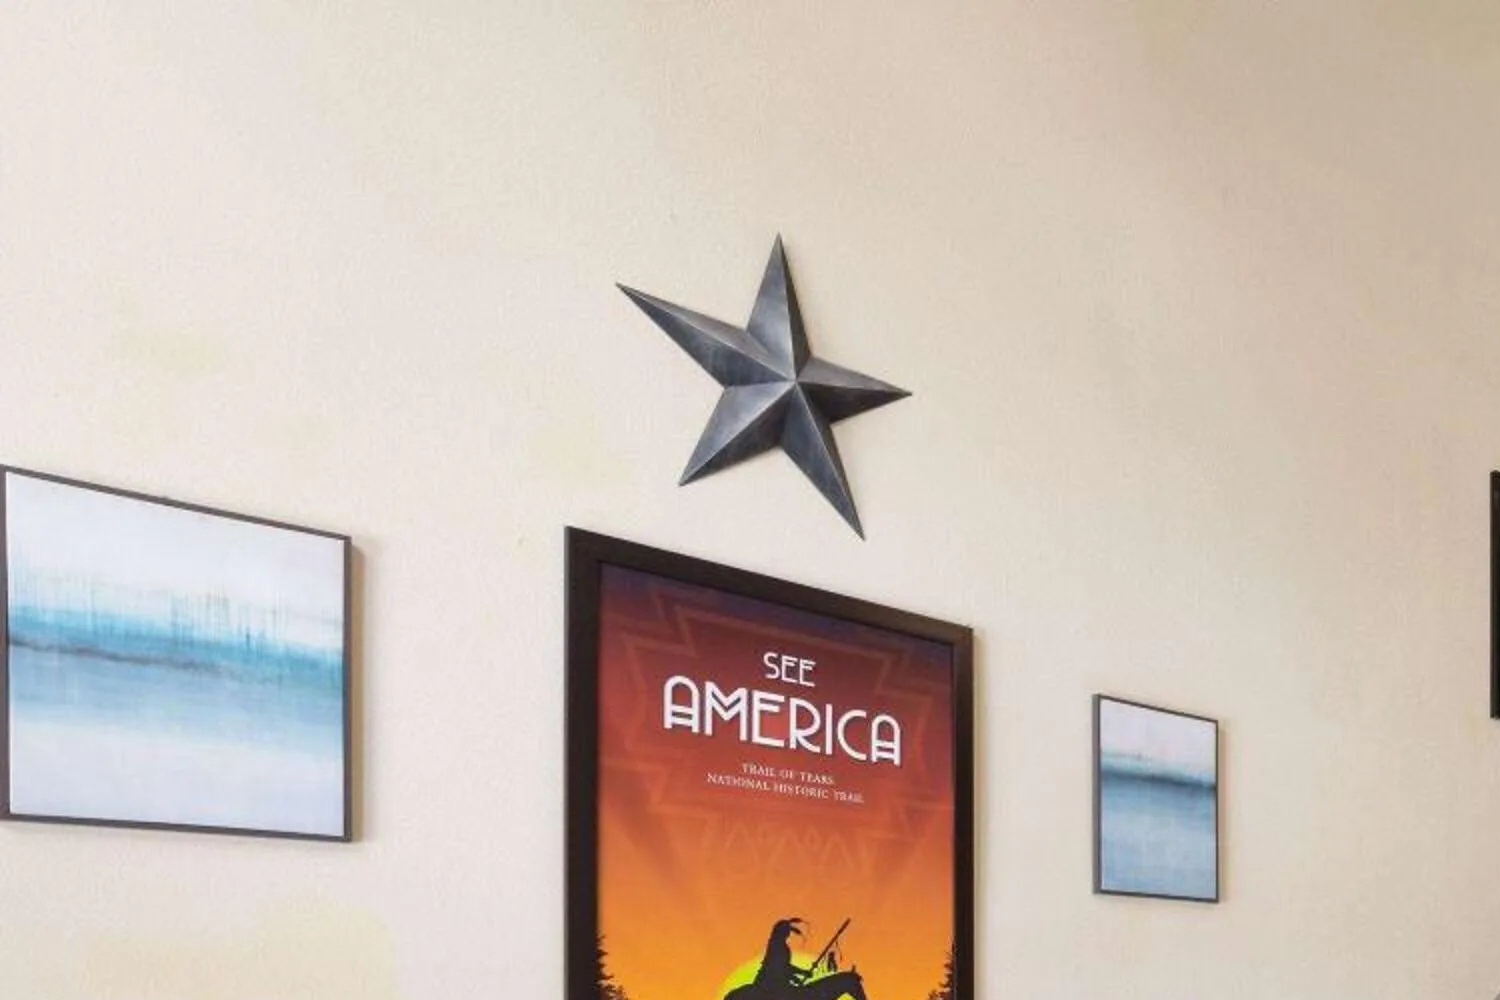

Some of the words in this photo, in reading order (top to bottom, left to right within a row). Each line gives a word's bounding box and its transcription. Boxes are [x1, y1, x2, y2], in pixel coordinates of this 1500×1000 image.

[763, 651, 817, 687] SEE
[663, 675, 901, 766] AMERICA
[706, 772, 771, 791] NATIONAL
[773, 782, 829, 799] HISTORIC
[833, 790, 865, 804] TRAIL
[742, 762, 777, 777] TRAIL
[778, 768, 795, 780] OF
[800, 770, 835, 785] TEARS
